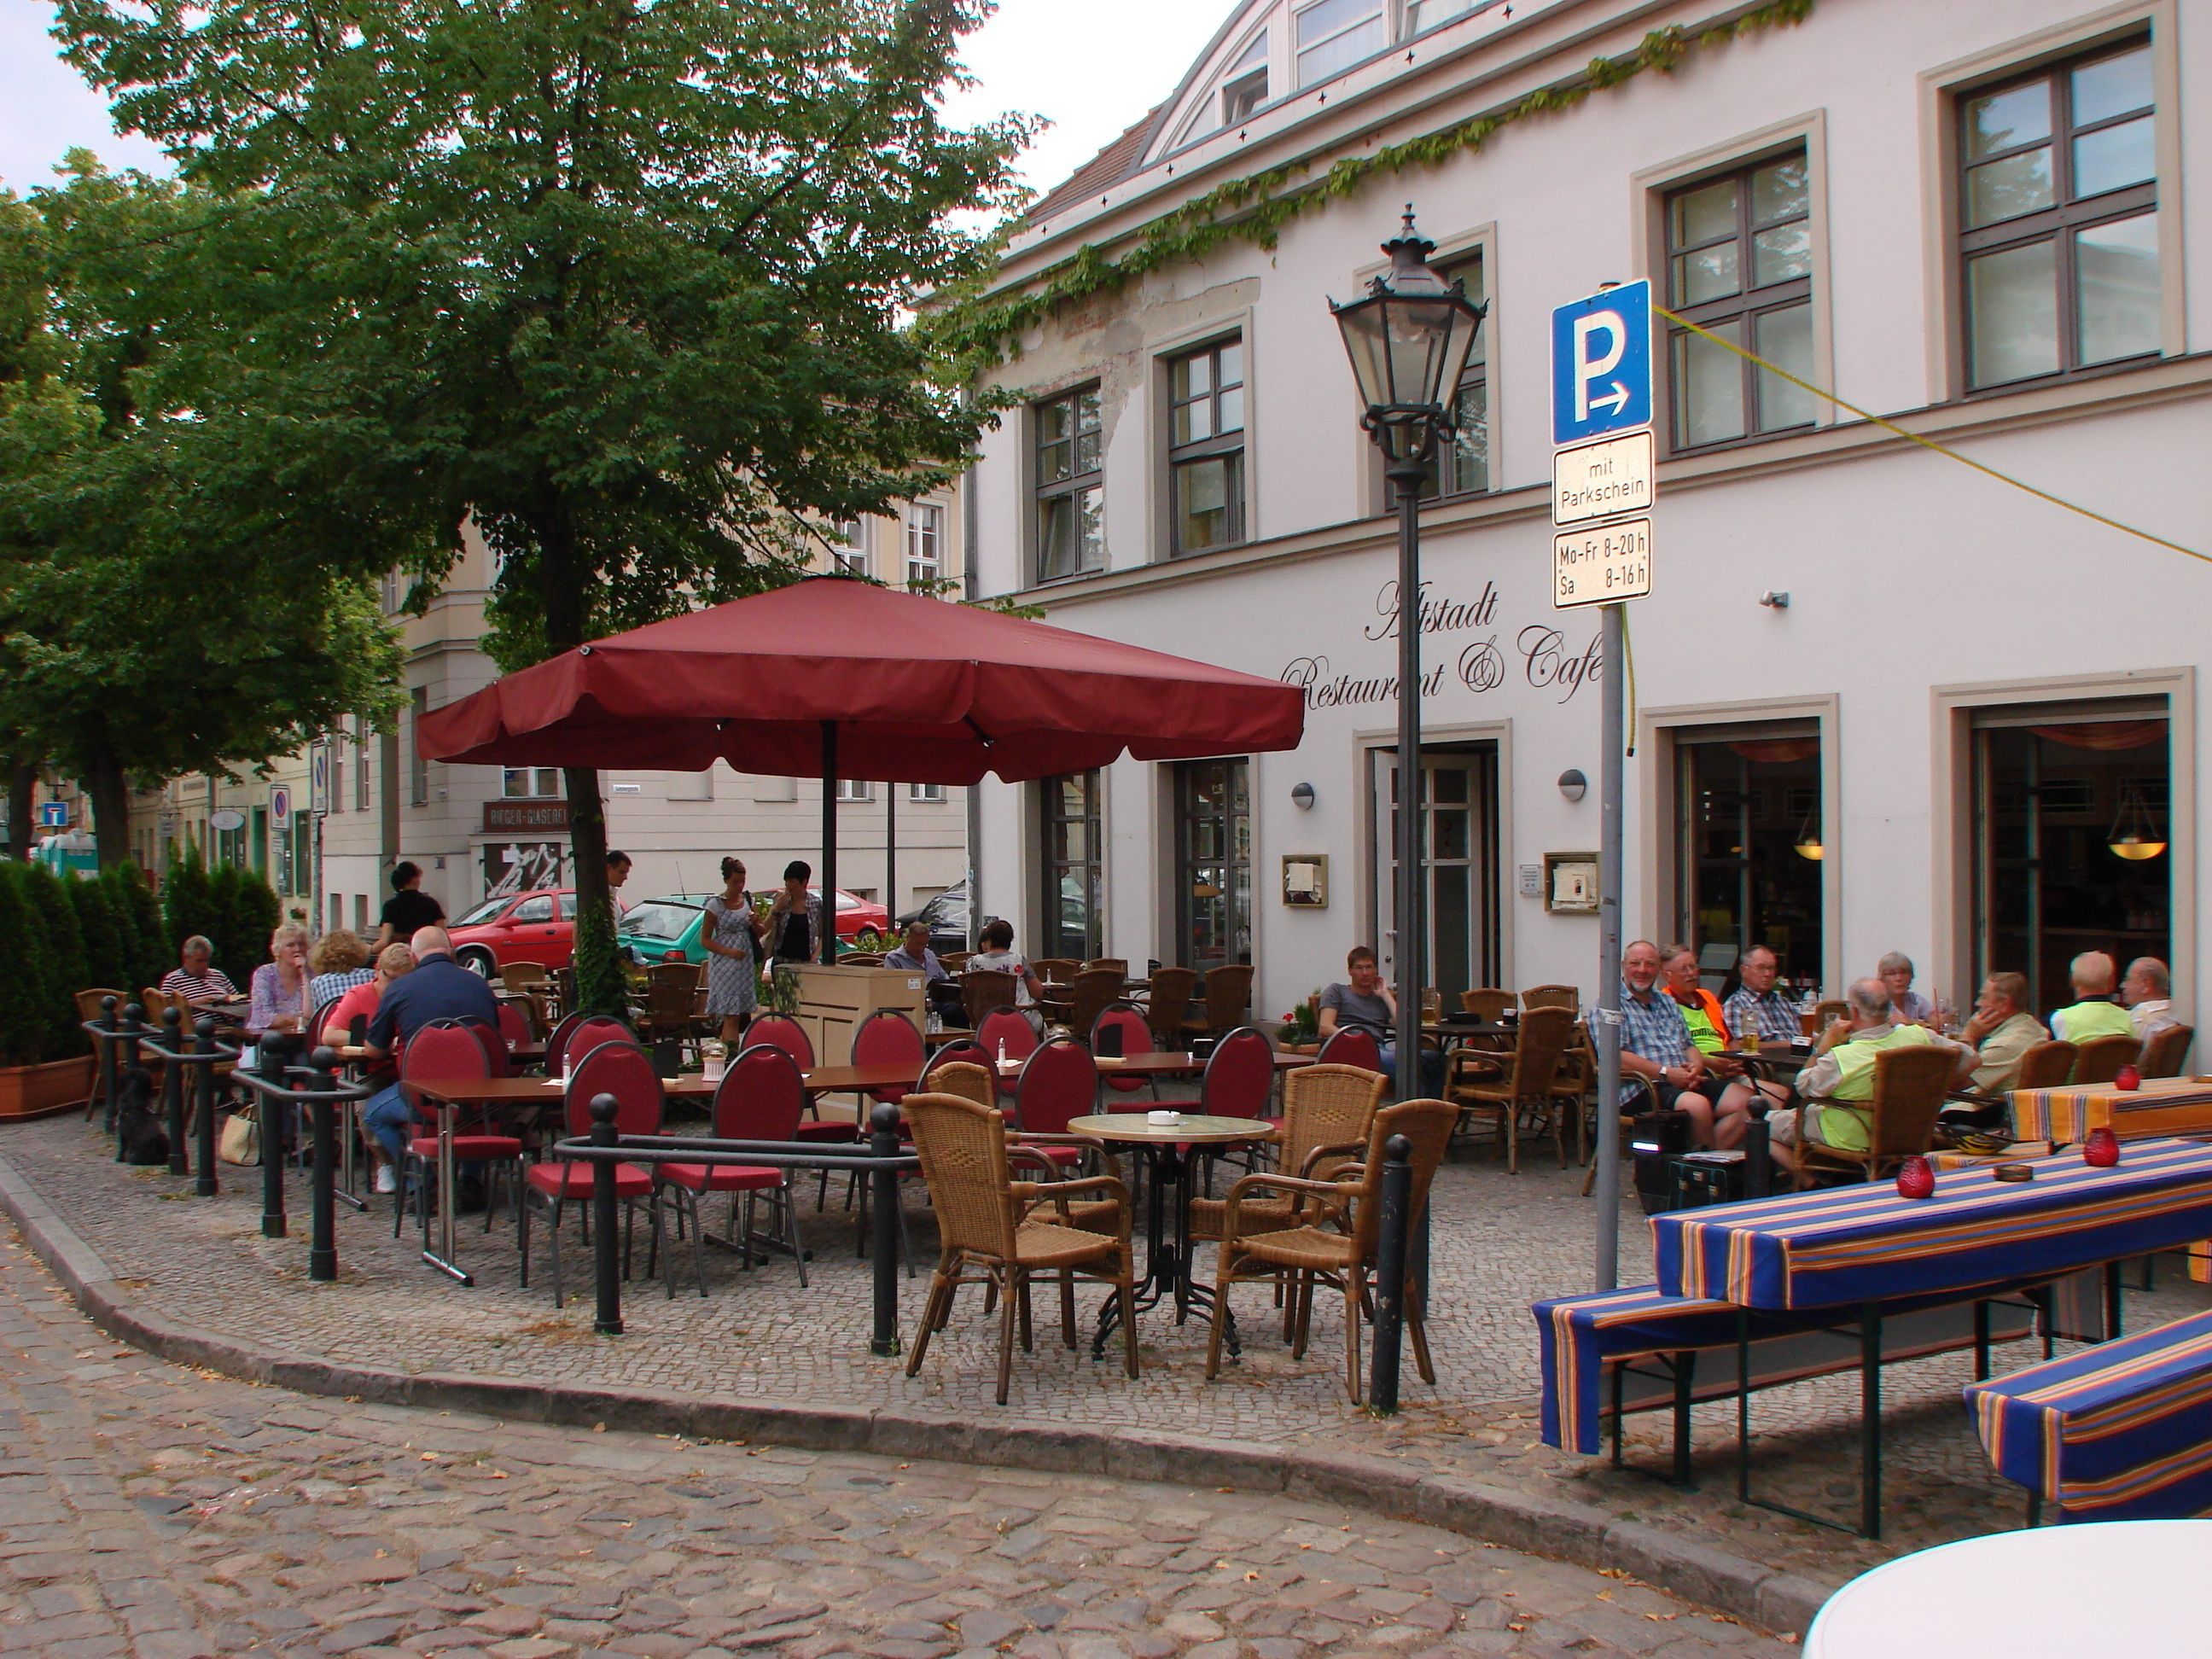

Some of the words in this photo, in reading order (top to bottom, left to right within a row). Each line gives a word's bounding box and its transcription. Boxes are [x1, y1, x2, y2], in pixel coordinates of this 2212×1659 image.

[1574, 310, 1625, 422] P
[1589, 457, 1614, 478] mit
[1562, 477, 1644, 509] Parkschein
[1560, 538, 1598, 567] Mo-Fr
[1604, 534, 1634, 559] 8-20
[1636, 533, 1645, 553] h
[1560, 576, 1575, 596] Sa
[1605, 566, 1634, 588] 8-16
[1637, 564, 1645, 584] h
[1365, 580, 1499, 642] Atstadt
[1458, 634, 1505, 693] &
